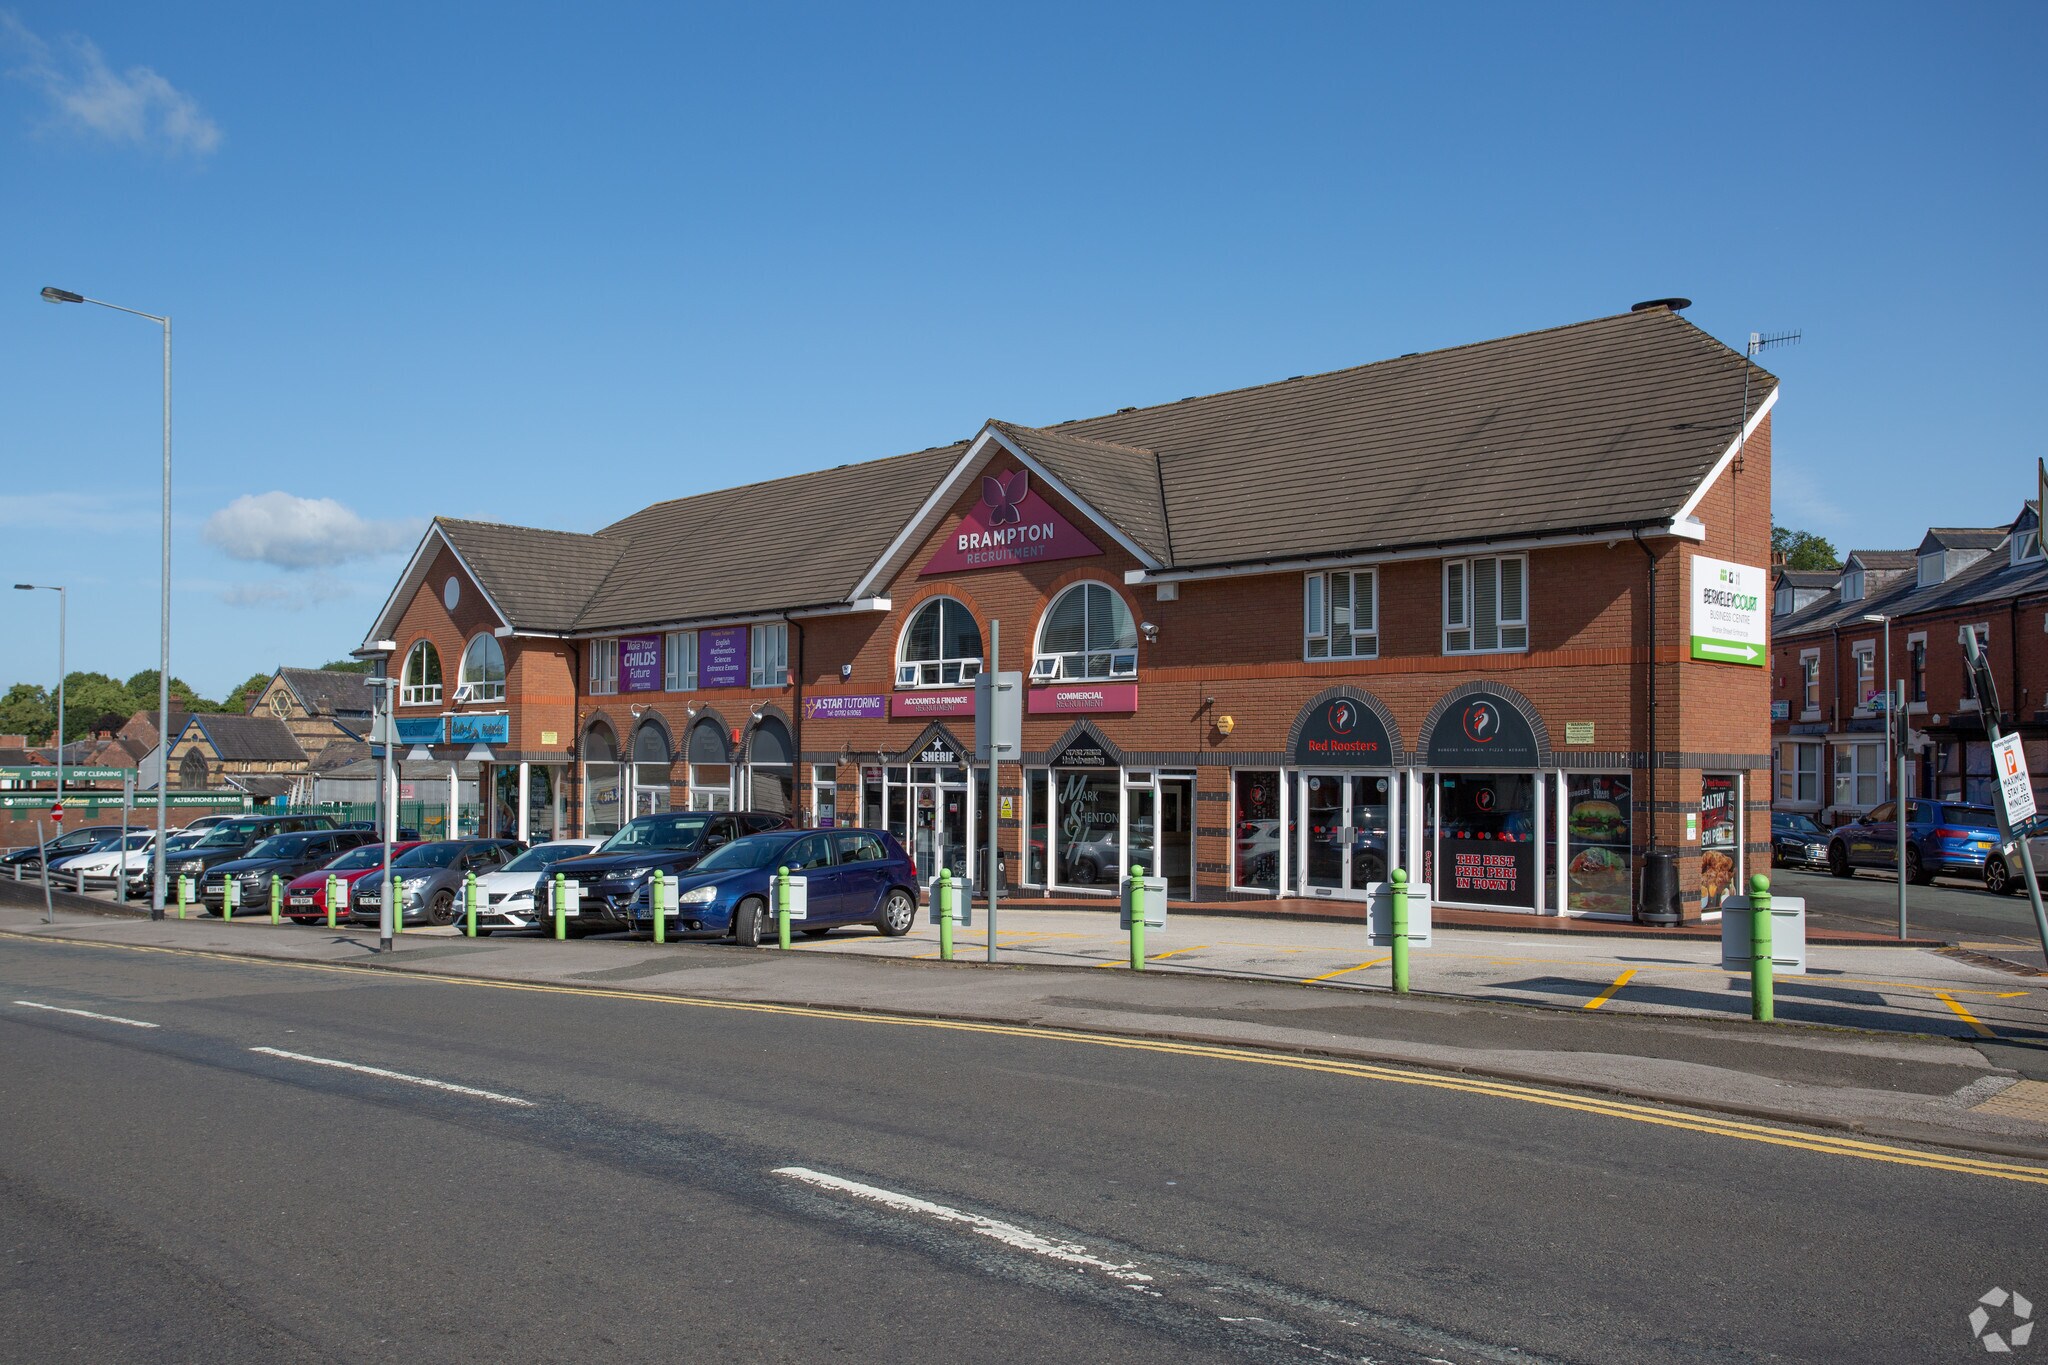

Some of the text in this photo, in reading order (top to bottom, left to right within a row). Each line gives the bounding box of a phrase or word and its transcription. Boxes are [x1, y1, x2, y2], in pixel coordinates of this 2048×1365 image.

[958, 522, 1054, 550] BRAMPTON
[967, 545, 1045, 564] RECRUITMENT
[1704, 588, 1758, 611] BERKELEYCOURT
[1710, 610, 1750, 624] BUSINESS CENTRE
[1733, 629, 1748, 637] Entrance
[627, 640, 654, 650] Make Your
[624, 651, 656, 667] CHILDS
[630, 668, 650, 679] Future
[815, 697, 880, 709] A STAR TUTORING
[1056, 692, 1103, 700] COMMERCIAL
[1308, 740, 1377, 751] Red Roosters
[921, 751, 954, 762] SHERIF
[2002, 771, 2027, 788] MAXIMUM
[1059, 774, 1099, 804] MARK
[2007, 787, 2019, 798] STAY
[1702, 792, 1725, 811] EALTHY
[2008, 793, 2030, 809] MINUTES
[1702, 830, 1711, 845] ERI
[1456, 854, 1515, 866] THE BEST
[1455, 866, 1517, 879] PERI PERI
[1456, 877, 1516, 891] IN TOWN !
